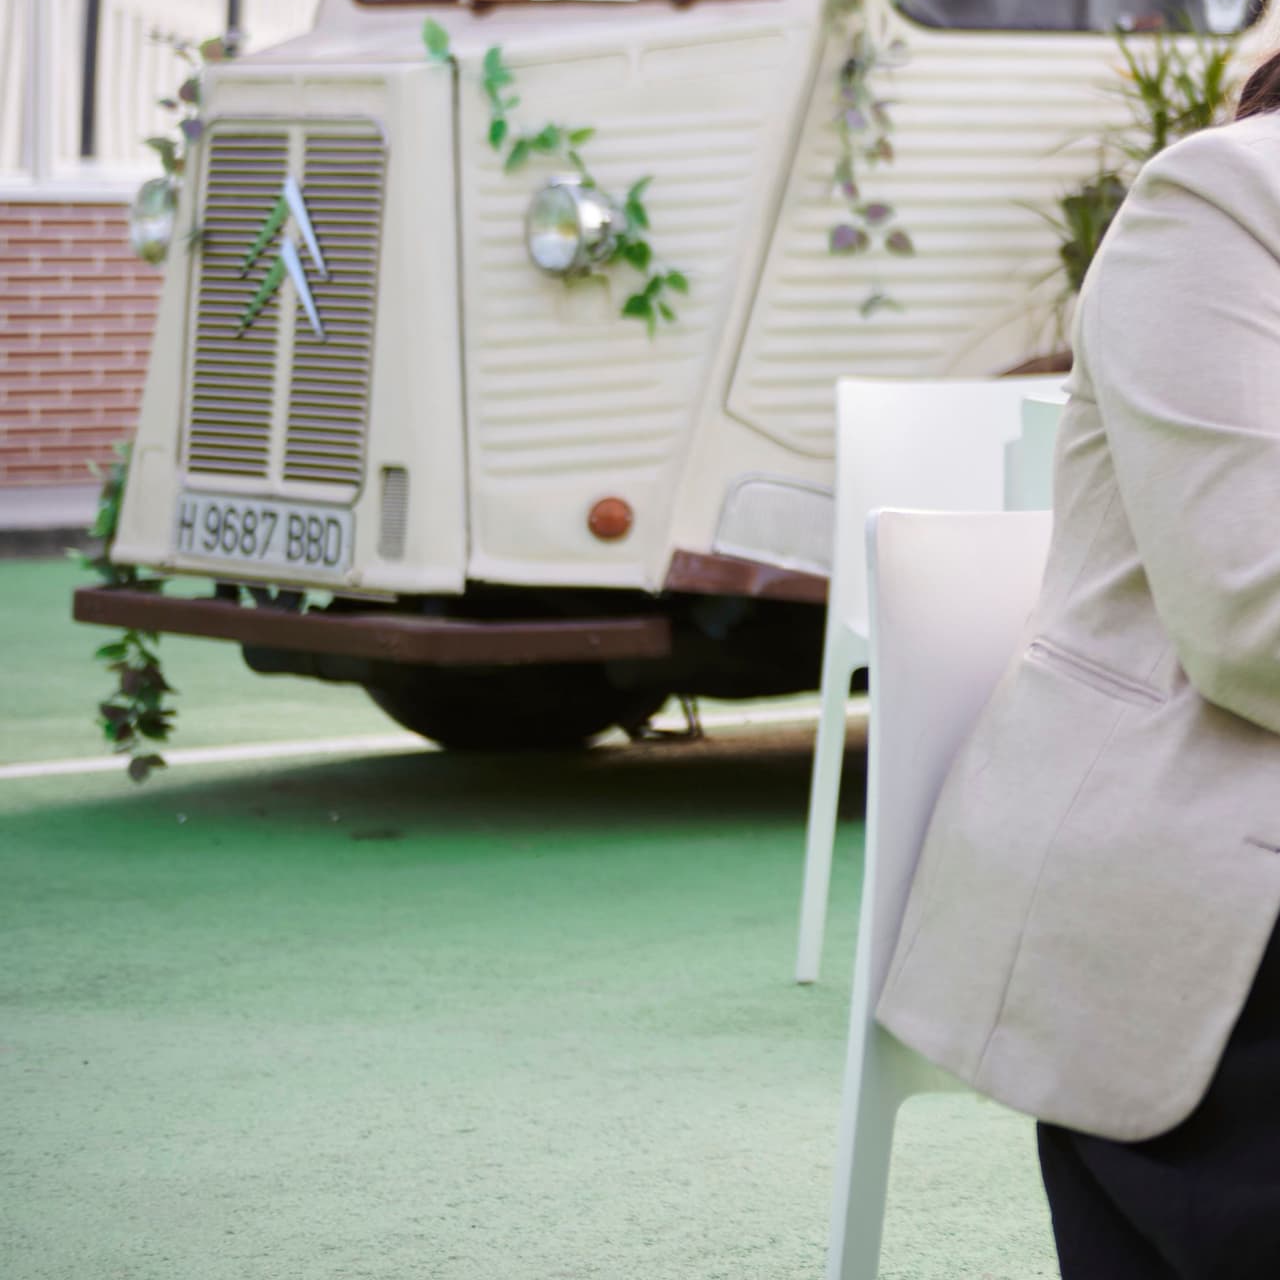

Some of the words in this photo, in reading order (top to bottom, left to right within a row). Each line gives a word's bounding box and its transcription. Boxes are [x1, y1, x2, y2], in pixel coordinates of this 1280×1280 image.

[178, 503, 197, 550] H
[203, 505, 280, 559] 9687
[286, 512, 343, 566] BBD
